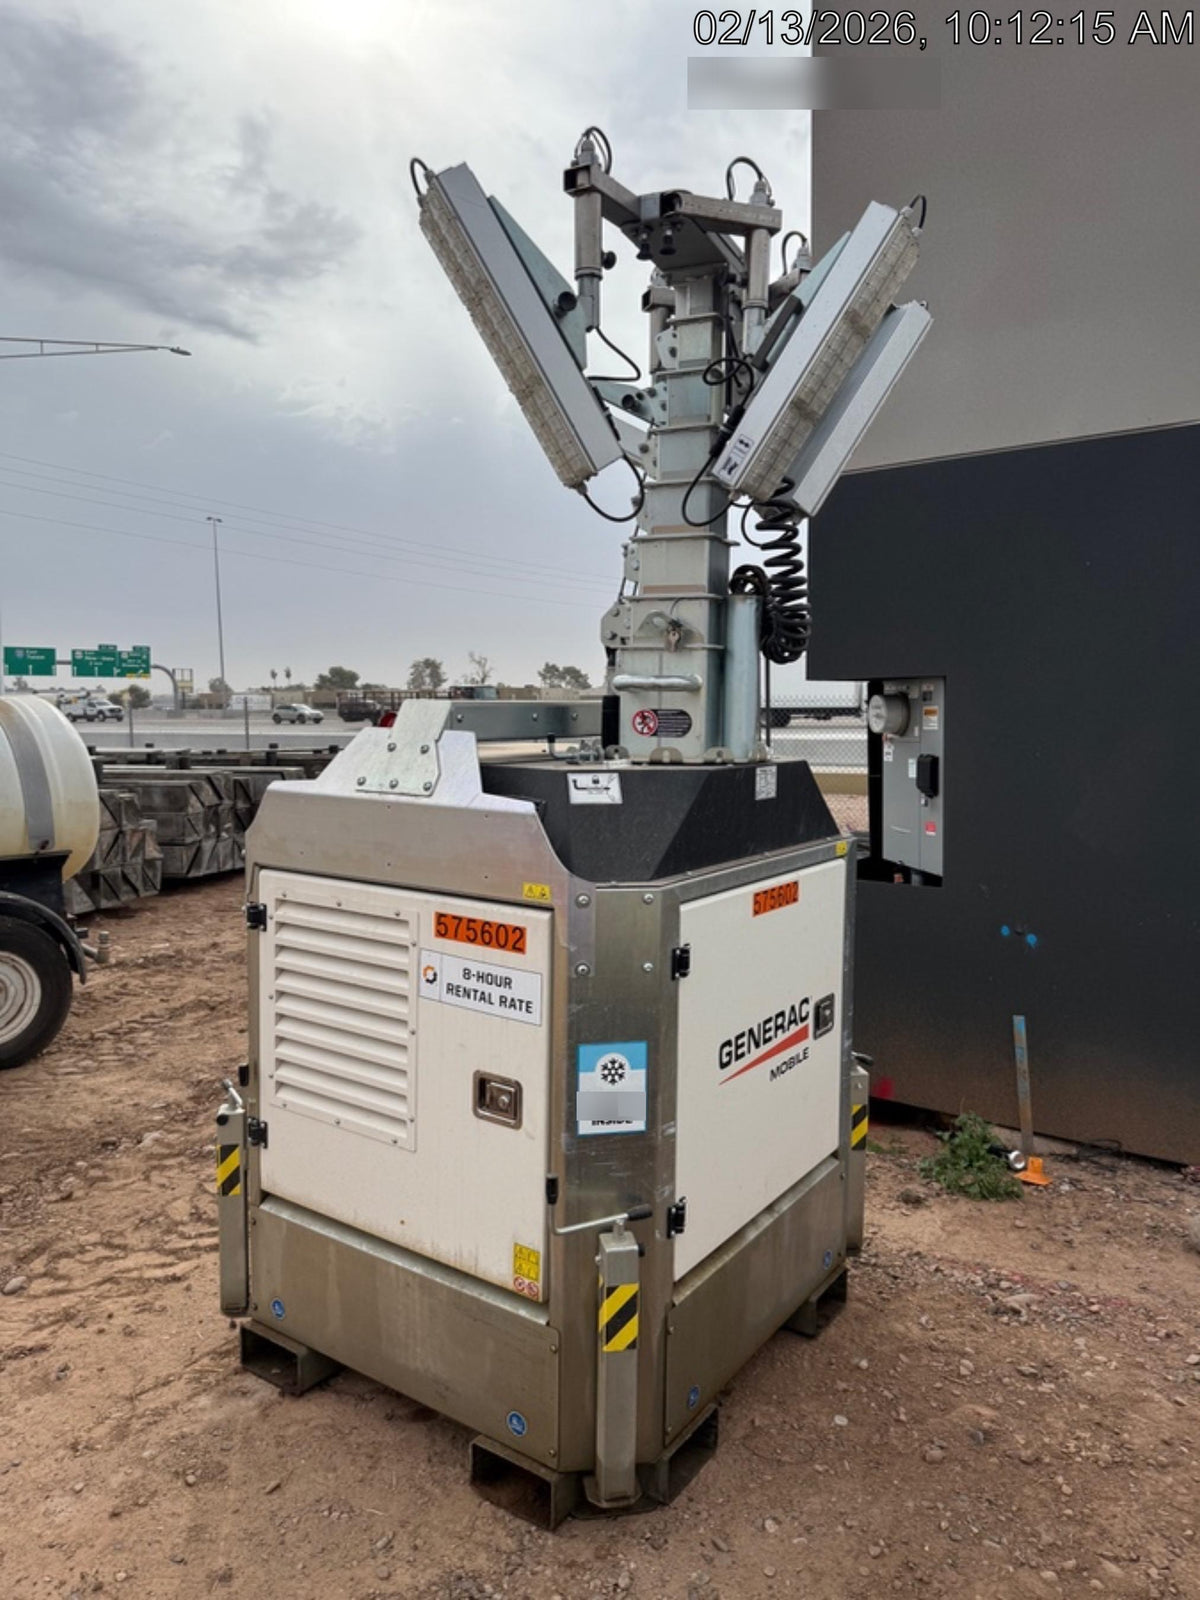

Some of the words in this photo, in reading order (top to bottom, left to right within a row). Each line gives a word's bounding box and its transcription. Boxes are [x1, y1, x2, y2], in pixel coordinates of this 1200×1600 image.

[753, 881, 799, 915] 575602
[436, 912, 526, 952] 575602
[462, 967, 513, 990] 8-HOUR
[446, 982, 495, 1006] RENTAL
[498, 995, 533, 1014] RATE
[718, 996, 810, 1070] GENERAC
[769, 1047, 810, 1082] MOBILE
